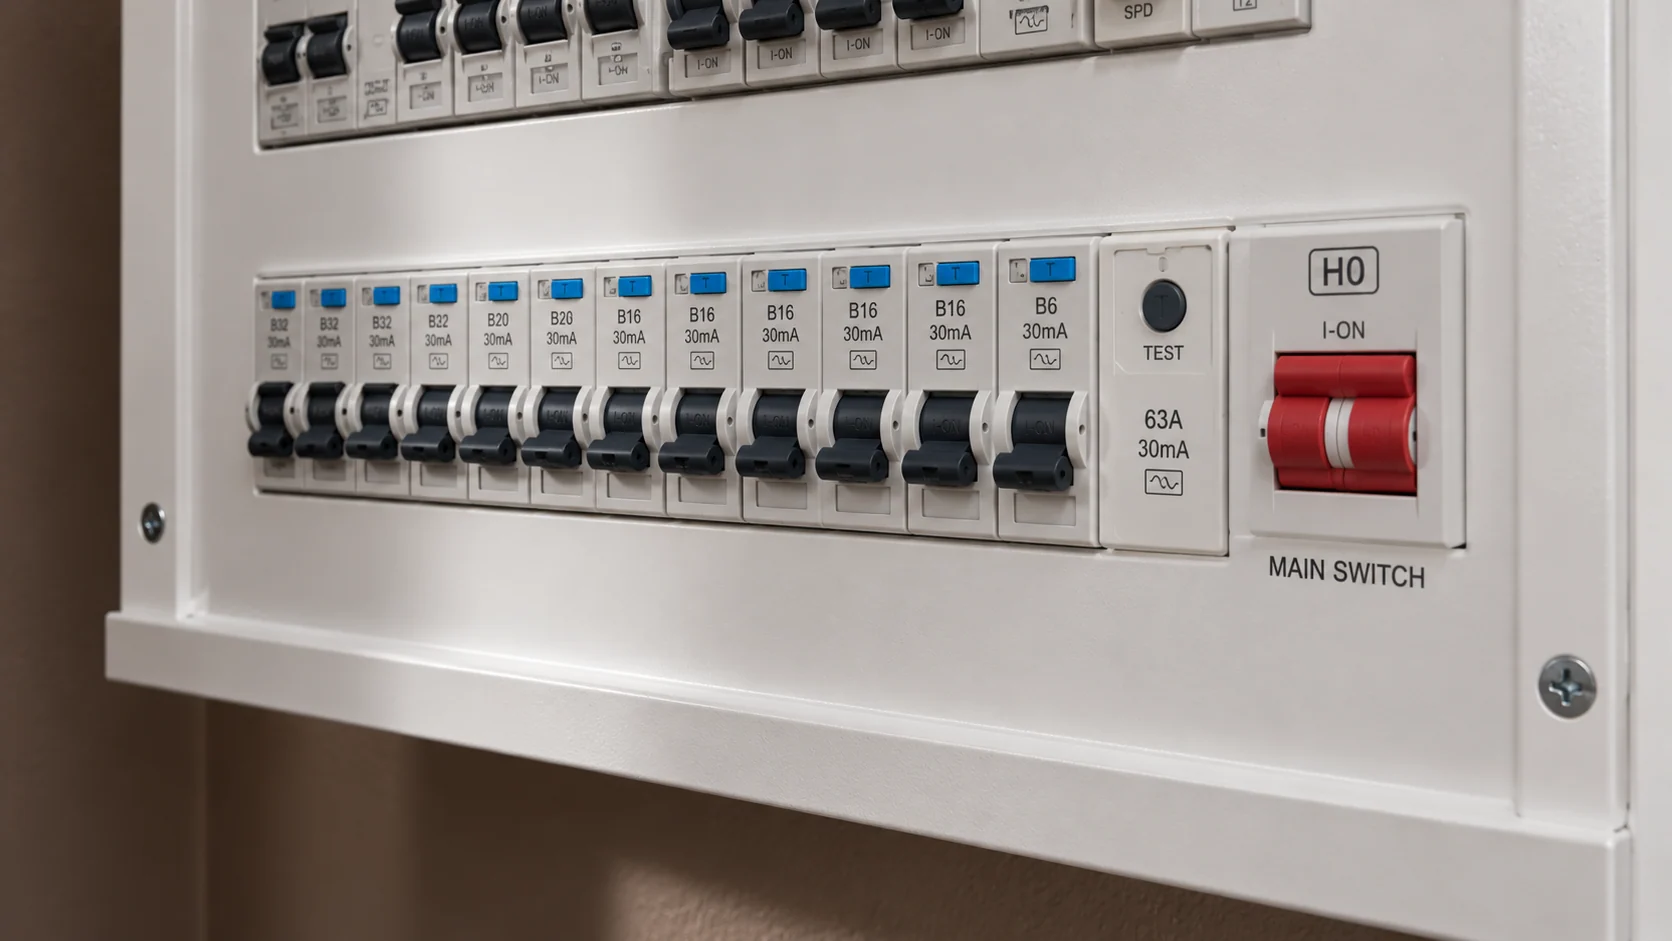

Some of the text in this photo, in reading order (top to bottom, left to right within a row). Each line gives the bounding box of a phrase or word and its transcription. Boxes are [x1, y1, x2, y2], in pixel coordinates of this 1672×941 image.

[1125, 3, 1153, 19] SPD
[926, 27, 951, 41] I-ON
[846, 37, 871, 51] I-ON
[770, 47, 793, 61] I-ON
[697, 56, 719, 70] I-ON
[951, 267, 960, 280] T
[1046, 262, 1055, 276] T
[1324, 256, 1364, 286] H0
[702, 278, 710, 288] T
[781, 274, 788, 286] T
[864, 270, 871, 284] T
[436, 287, 443, 298] T
[498, 286, 504, 296] T
[561, 284, 568, 294] T
[630, 281, 636, 292] T
[768, 305, 794, 320] B16
[850, 302, 877, 318] B16
[936, 300, 965, 316] B16
[1036, 297, 1057, 314] B6
[488, 313, 509, 326] B20
[618, 309, 641, 324] B16
[690, 307, 714, 322] B16
[271, 318, 288, 332] B32
[320, 317, 338, 331] B32
[373, 316, 391, 329] B32
[613, 330, 645, 344] 30mA
[685, 329, 719, 343] 30mA
[763, 328, 799, 342] 30mA
[844, 326, 883, 341] 30mA
[930, 325, 971, 340] 30mA
[1023, 323, 1067, 339] 30mA
[1323, 321, 1364, 339] I-ON
[268, 336, 290, 348] 30mA
[317, 335, 341, 348] 30mA
[369, 334, 395, 347] 30mA
[425, 334, 452, 346] 30mA
[484, 333, 512, 346] 30mA
[547, 332, 577, 345] 30mA
[1143, 345, 1184, 360] TEST
[1145, 409, 1182, 429] 63A
[1139, 439, 1189, 459] 30mA
[1270, 556, 1424, 588] MAIN SWITCH
